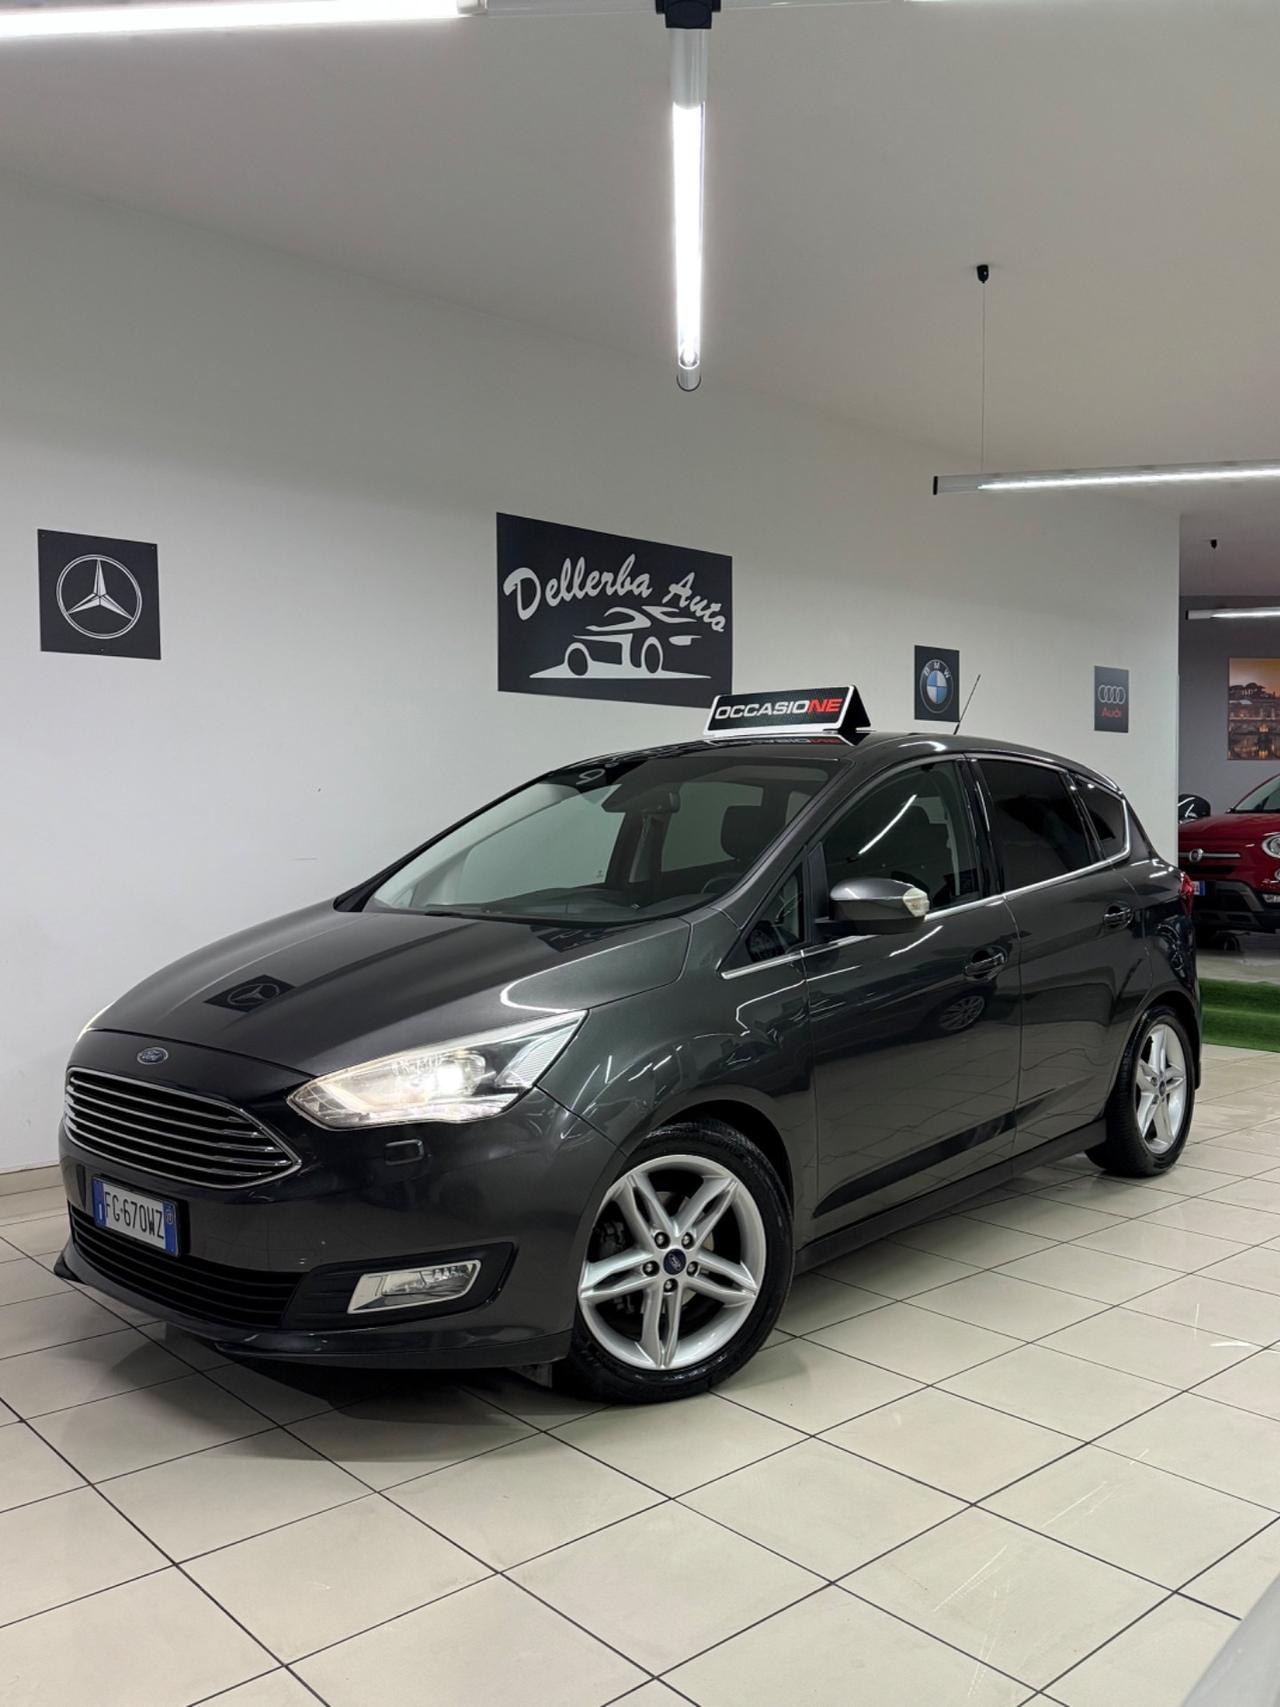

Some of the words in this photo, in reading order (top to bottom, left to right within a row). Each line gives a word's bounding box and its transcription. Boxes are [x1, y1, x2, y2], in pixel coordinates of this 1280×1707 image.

[503, 553, 653, 621] Dellerba
[662, 572, 726, 632] Auto
[923, 661, 951, 679] BMW
[714, 698, 844, 720] OCCASIONE
[1101, 706, 1122, 718] Audi
